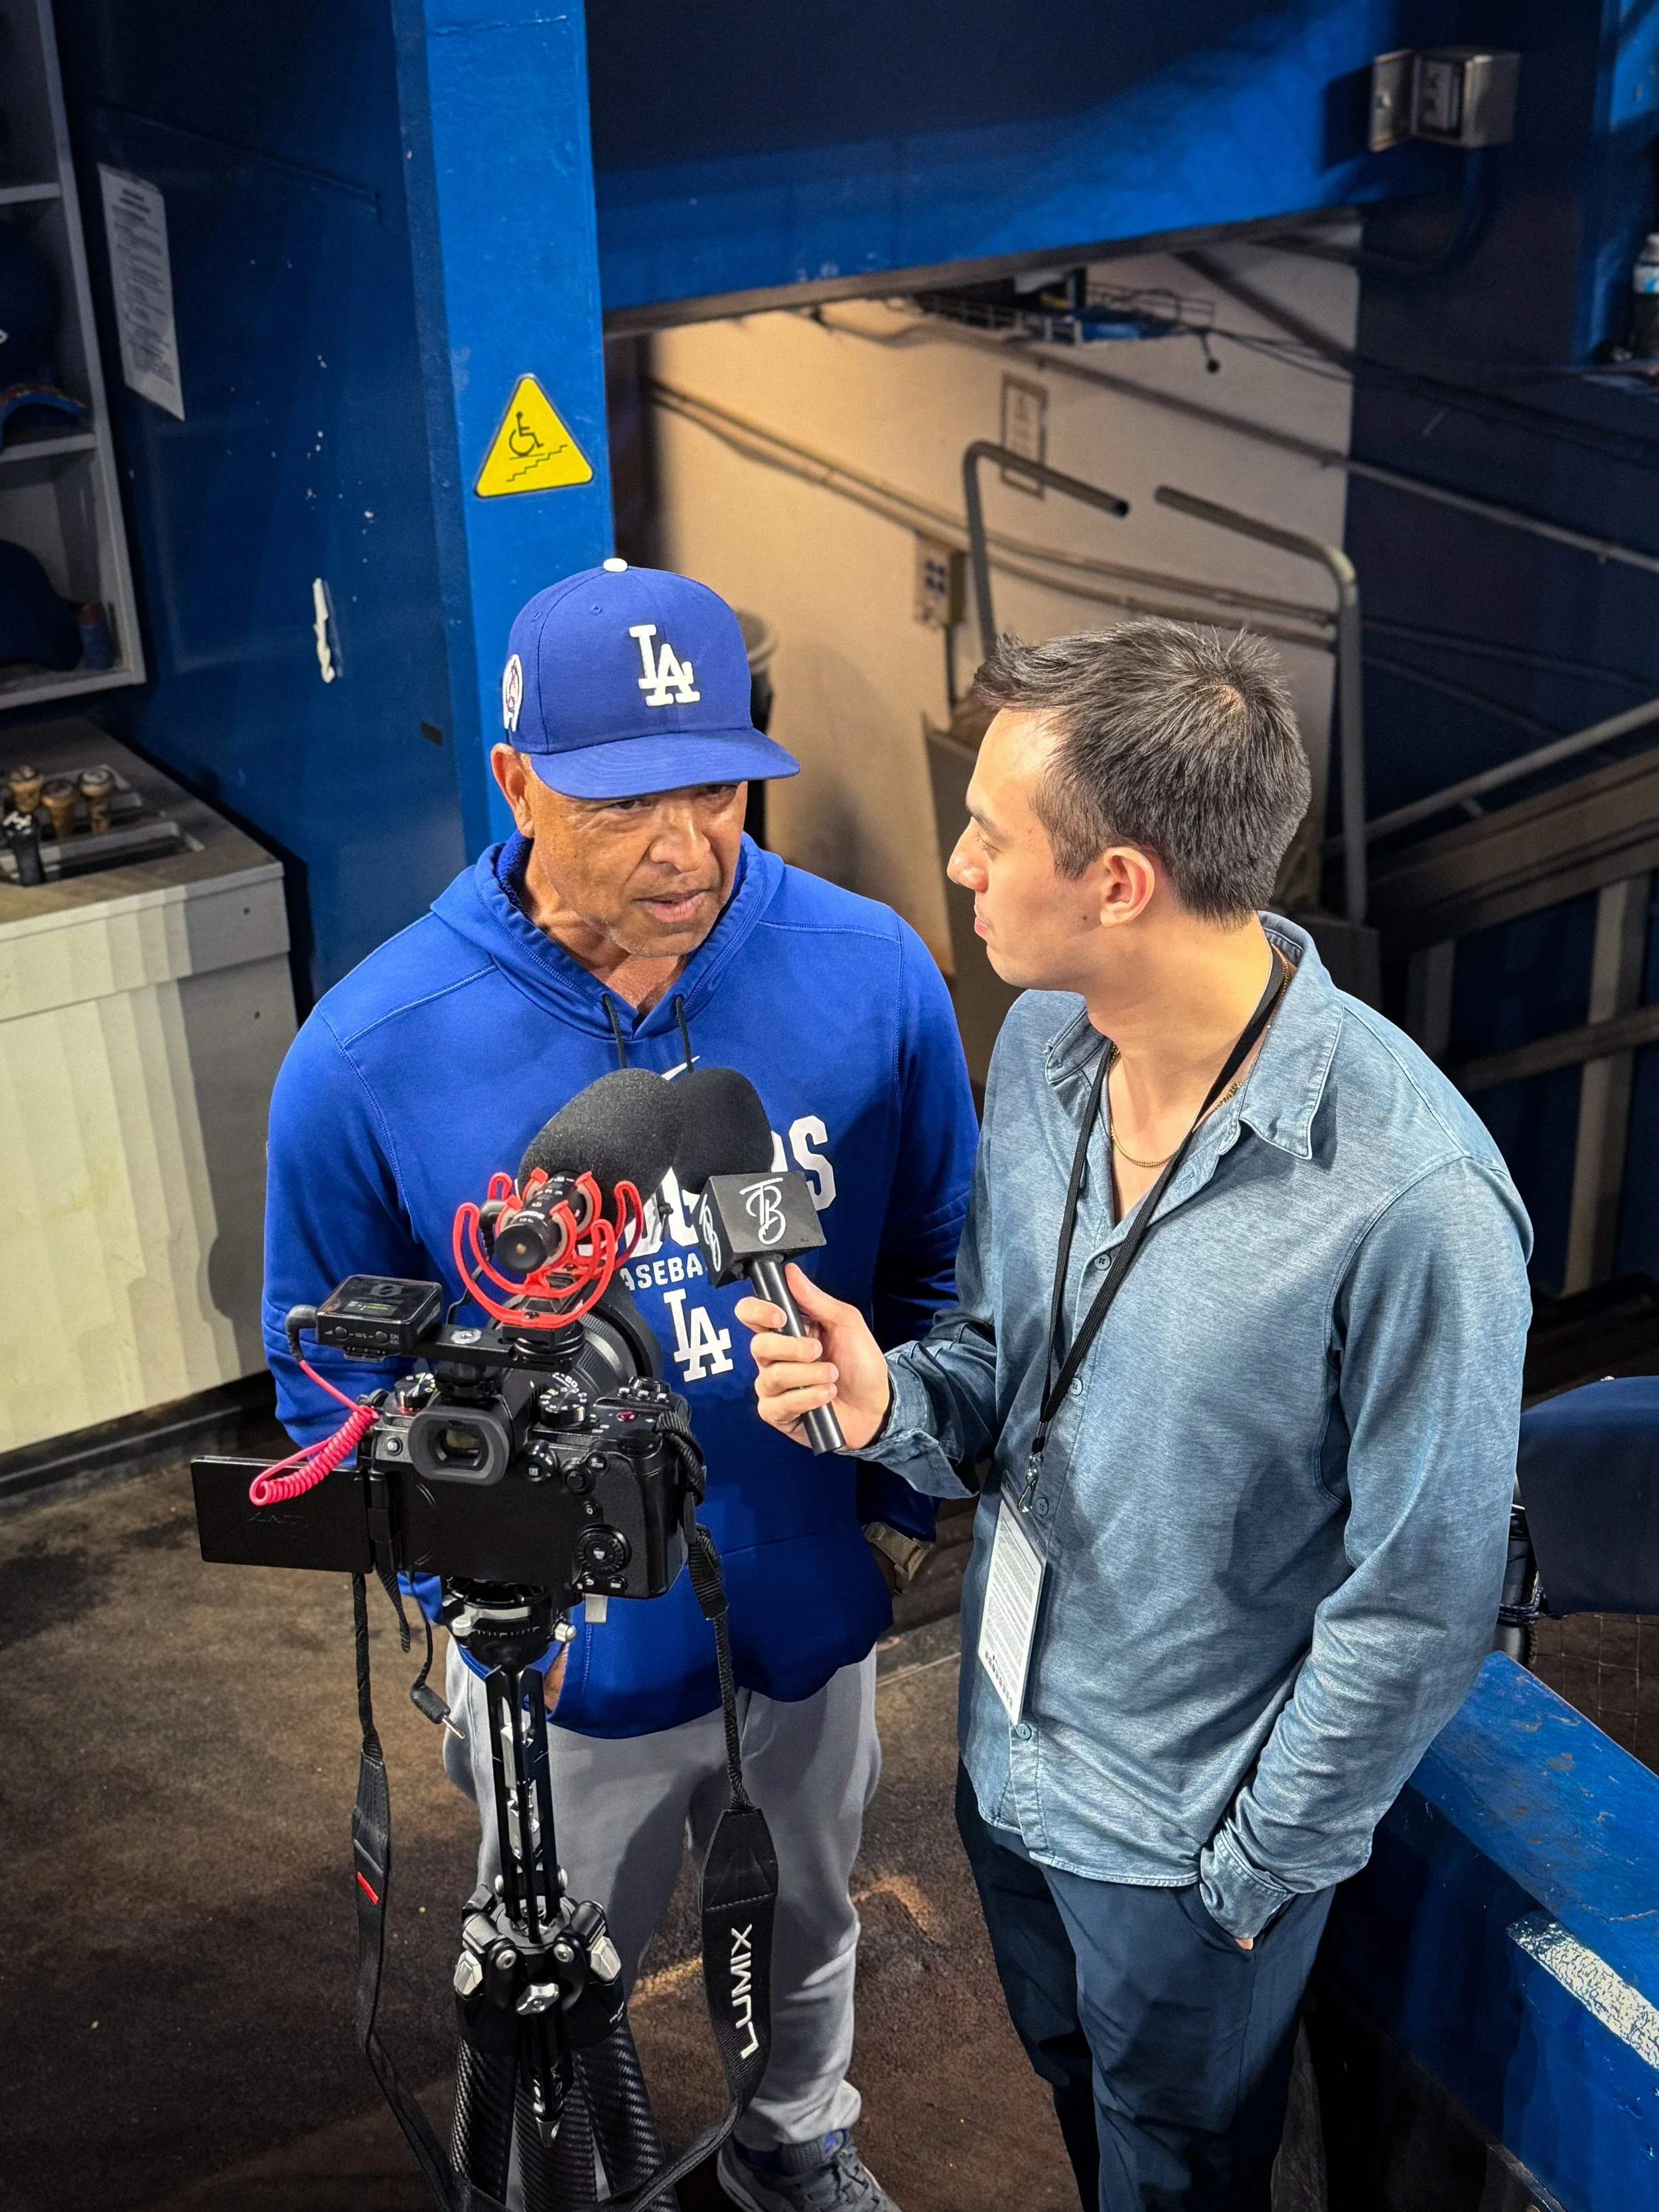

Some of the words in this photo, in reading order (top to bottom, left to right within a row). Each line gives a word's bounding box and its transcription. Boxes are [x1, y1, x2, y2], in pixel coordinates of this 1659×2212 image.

[629, 624, 701, 707] LA
[618, 1252, 704, 1291] ASEBA
[663, 1288, 734, 1382] LA
[730, 1923, 759, 2059] LUMIX
